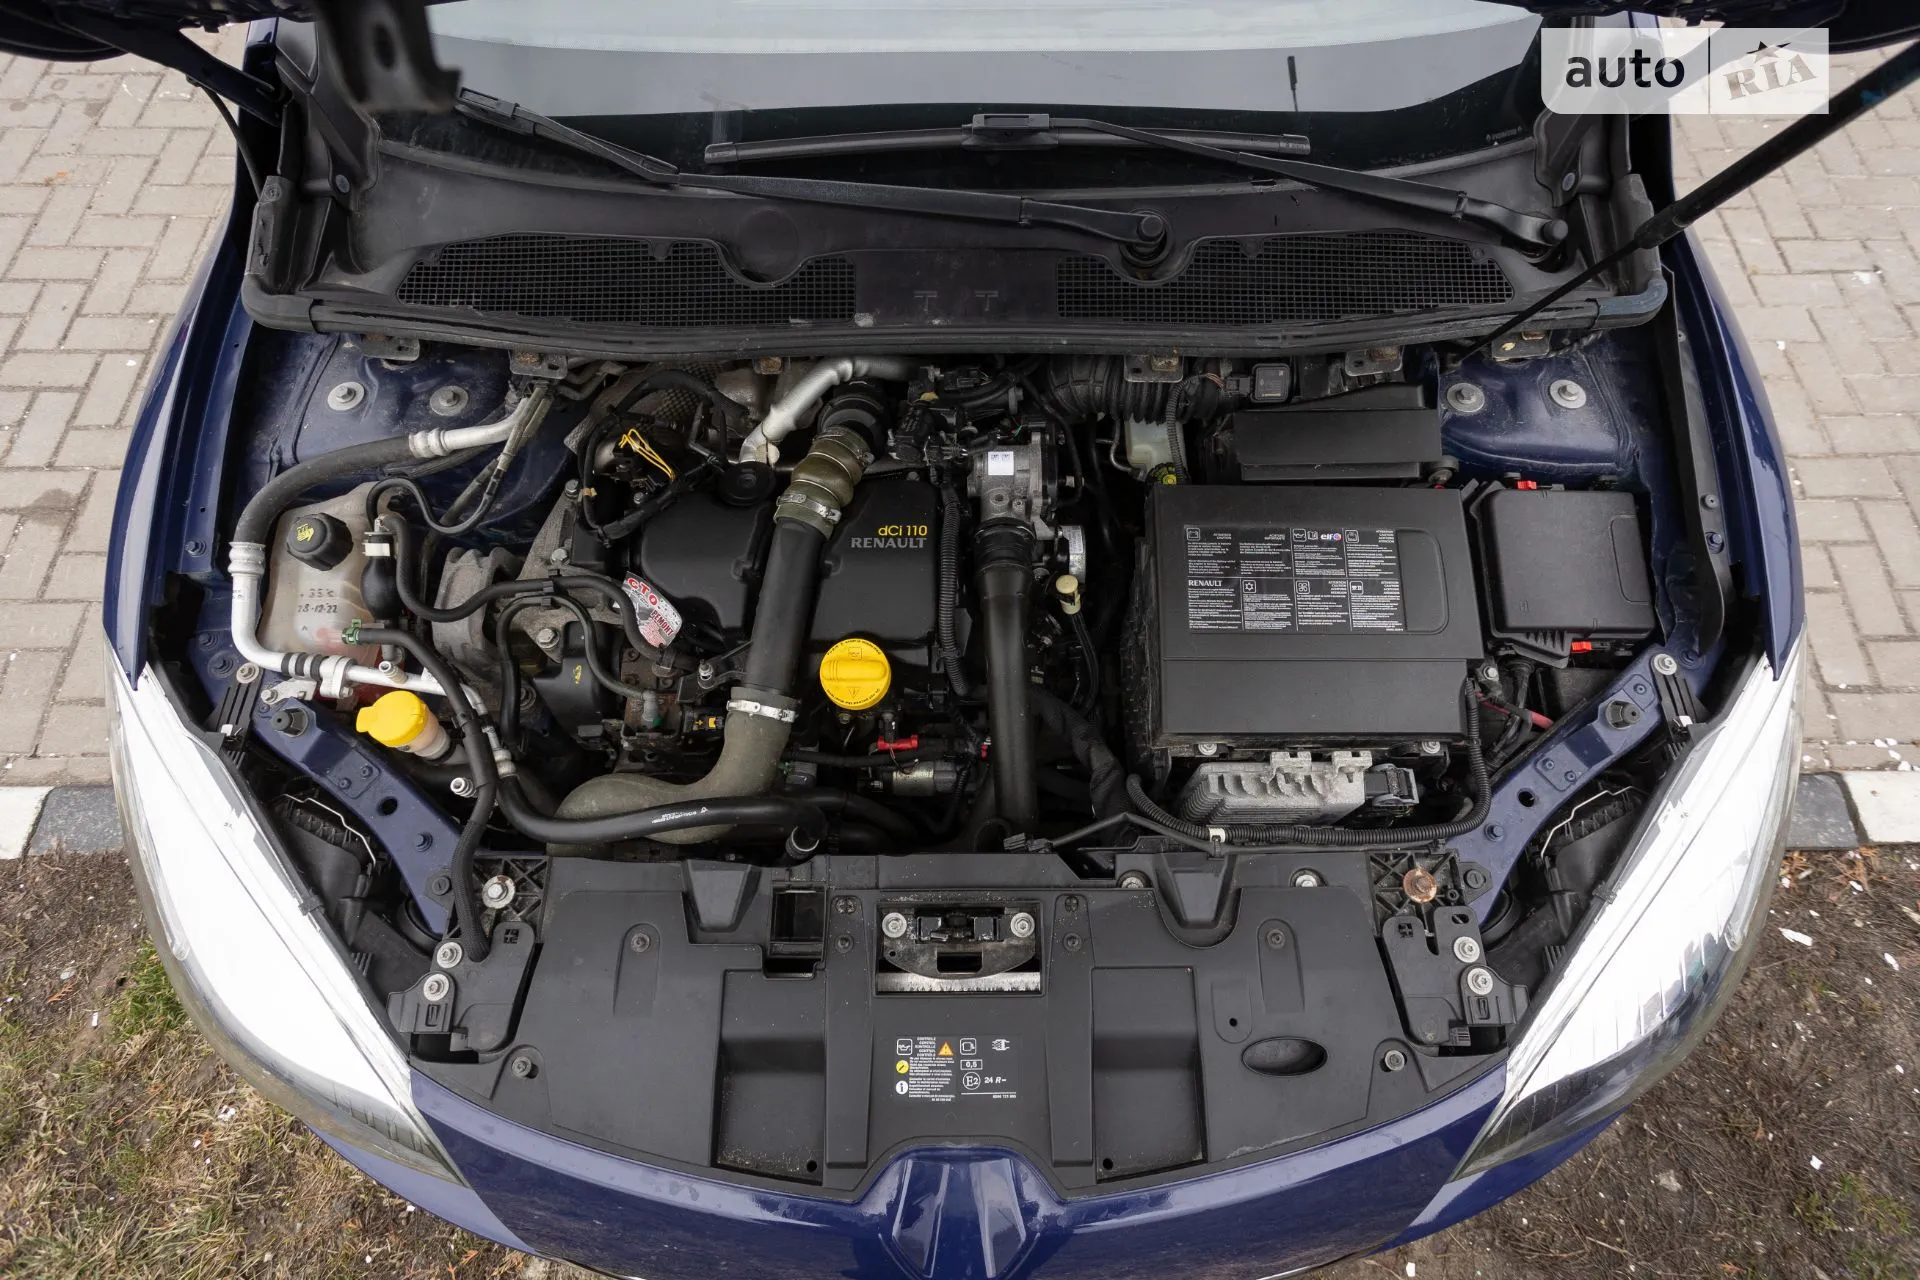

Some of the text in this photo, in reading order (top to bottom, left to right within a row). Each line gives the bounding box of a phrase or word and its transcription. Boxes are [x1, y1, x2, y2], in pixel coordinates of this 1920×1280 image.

[878, 525, 928, 536] dCi 110
[851, 537, 928, 549] RENAULT
[1188, 579, 1223, 587] RENAULT
[650, 609, 675, 636] РЕМОНТ
[965, 1075, 979, 1087] E2
